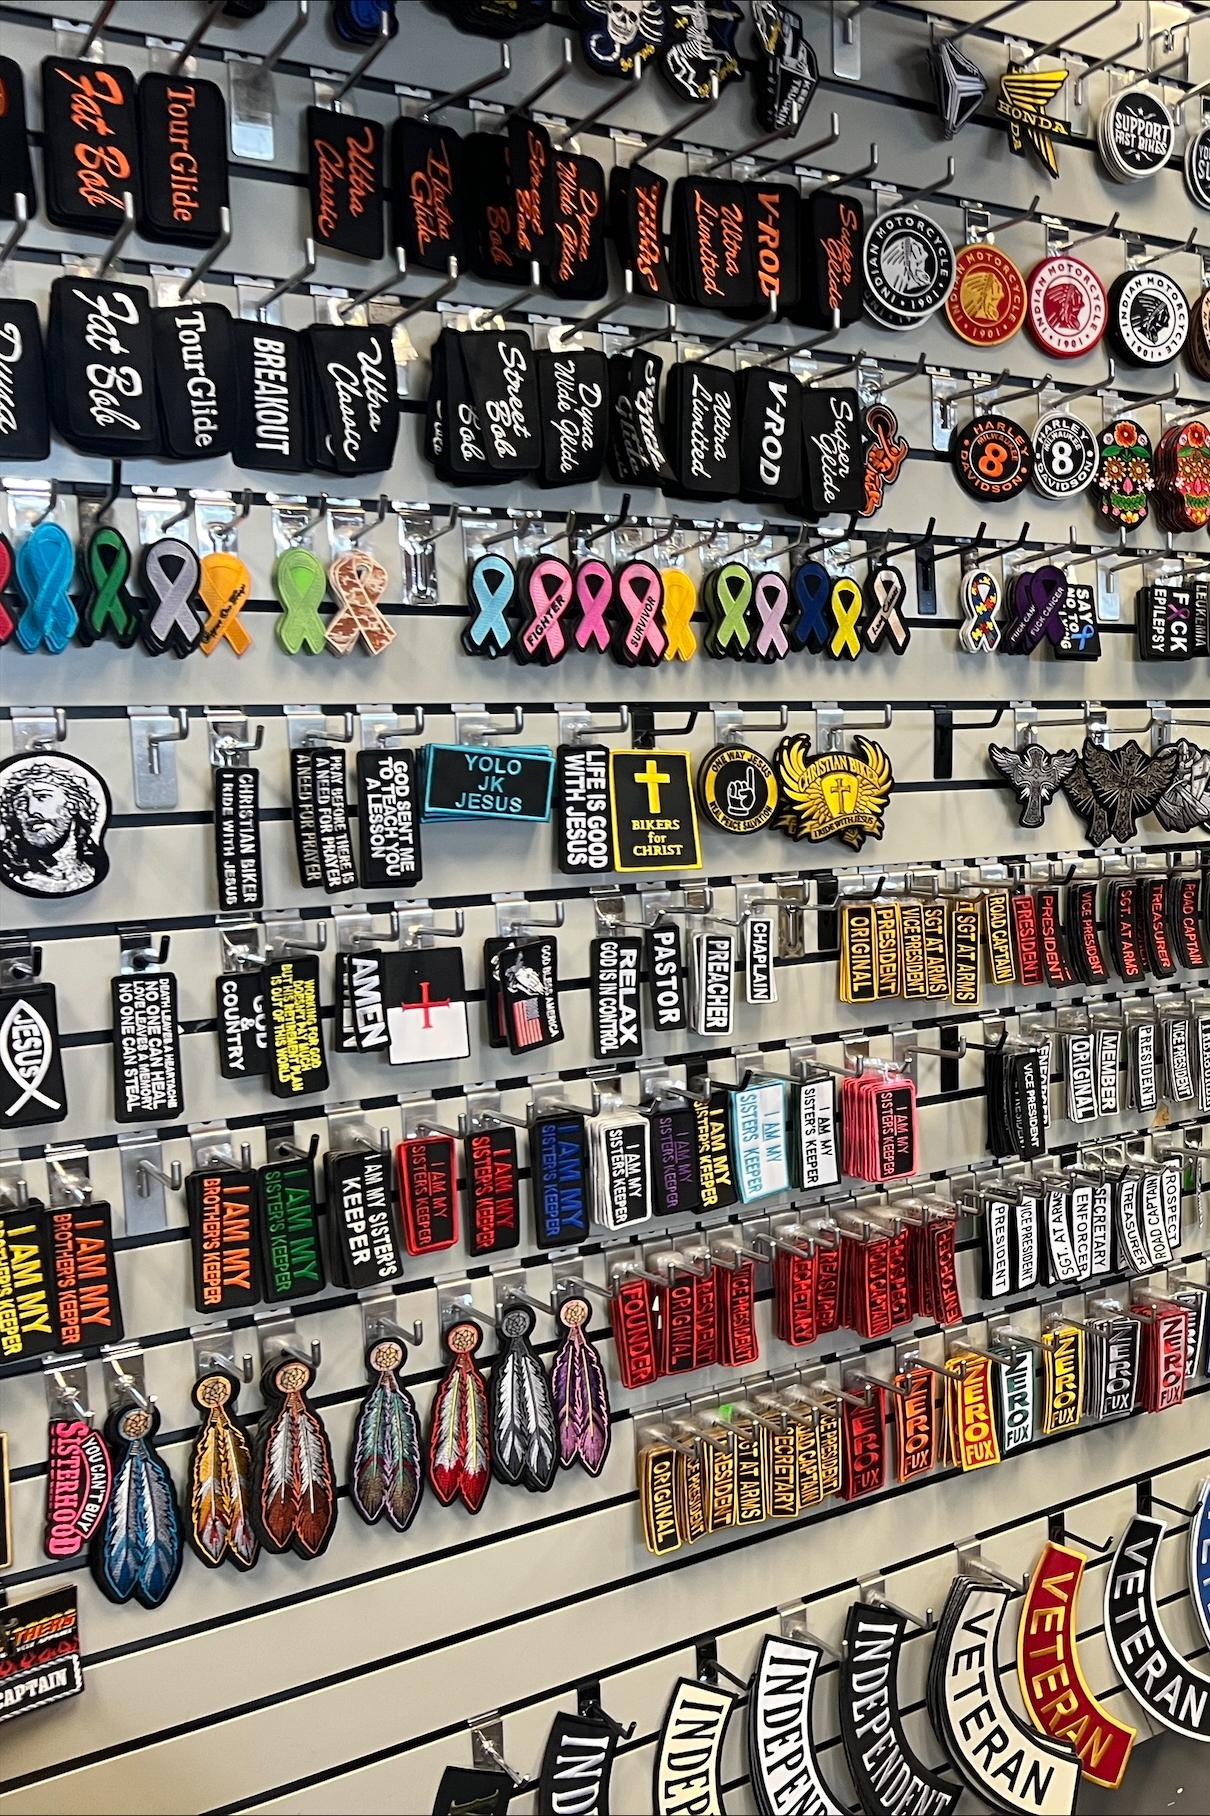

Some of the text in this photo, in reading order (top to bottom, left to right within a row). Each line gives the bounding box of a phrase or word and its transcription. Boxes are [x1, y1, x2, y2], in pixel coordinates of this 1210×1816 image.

[998, 99, 1070, 136] HONDA
[1115, 113, 1171, 140] SUPPORT
[1115, 130, 1167, 156] FAST BIKES
[314, 138, 338, 238] Classic
[347, 126, 376, 218] Ultra
[693, 189, 725, 297] Limited
[720, 203, 744, 277] Ultra
[756, 192, 781, 297] V-ROD
[838, 203, 857, 293] Super
[72, 288, 143, 432] Fat Bob
[253, 336, 290, 456] BREAKOUT
[356, 337, 388, 433] Ultra
[498, 341, 530, 439] Street
[327, 362, 356, 462] Classic
[577, 382, 602, 452] Dyna
[691, 373, 712, 479] Limited
[712, 390, 733, 463] Ultra
[759, 380, 790, 487] V-ROD
[828, 396, 852, 480] Super
[973, 421, 1030, 457] HARLEY
[1037, 419, 1089, 444] HARLEY
[812, 434, 838, 505] Glide
[961, 450, 1023, 493] DAVIDSON
[978, 442, 1008, 477] 8
[1036, 461, 1094, 491] DAVIDSON
[1051, 441, 1073, 475] 8
[526, 594, 567, 647] FIGHTER
[629, 594, 656, 648] SURVIVOR
[1043, 586, 1065, 617] CANCER
[1076, 588, 1093, 625] SAY
[1152, 588, 1167, 652] EPILEPSY
[455, 791, 523, 813] JESUS
[463, 754, 522, 774] YOLO
[477, 776, 503, 793] JK
[727, 751, 773, 779] WAY JESUS
[799, 754, 849, 791] CHRISTIAN
[222, 783, 238, 906] RIDE WITH JESUS
[238, 773, 257, 903] CHRISTIAN BIKER
[367, 793, 386, 859] LESSON
[378, 756, 401, 877] TO TEACH YOU
[393, 761, 415, 873] GOD SENT ME
[564, 754, 588, 868] WITH JESUS
[585, 749, 609, 870] LIFE GOOD
[631, 818, 681, 831] BIKERS
[632, 844, 683, 857] CHRIST
[647, 832, 667, 844] for
[751, 922, 770, 1000] CHAPLAIN
[850, 916, 872, 992] ORIGINAL
[877, 909, 897, 994] PRESIDENT
[956, 915, 976, 1001] SGT AT ARMS
[989, 896, 1012, 979] ROAD CAPTAIN
[1041, 895, 1064, 982] PRESIDENT
[1151, 884, 1171, 969] TREASURER
[352, 957, 388, 1049] AMEN
[599, 942, 619, 1054] GOD CONTROL
[619, 949, 638, 1046] RELAX
[653, 932, 680, 1024] PASTOR
[706, 939, 729, 1029] PREACHER
[9, 1014, 43, 1080] JESUS
[118, 983, 142, 1113] NO ONE CAN STEAL
[222, 980, 246, 1071] COUNTRY
[1071, 1038, 1095, 1121] ORIGINAL
[1100, 1034, 1119, 1111] MEMBER
[803, 1088, 819, 1184] SISTER'S KEEPER
[203, 1177, 222, 1305] BROTHER'S KEEPER
[223, 1201, 251, 1290] AM MY
[342, 1177, 372, 1266] KEEPER
[364, 1164, 398, 1278] AM MY SISTER'S
[994, 1206, 1006, 1287] PRESIDENT
[1093, 1188, 1107, 1267] SECRETARY
[1124, 1184, 1147, 1266] TREASURER
[621, 1286, 651, 1384] FOUNDER
[670, 1286, 692, 1367] ORIGINAL
[1161, 1318, 1182, 1386] ZERO
[963, 1362, 994, 1463] ZERO FUX
[48, 1421, 88, 1555] SISTERHOOD
[652, 1461, 676, 1544] ORIGINAL
[1028, 1571, 1115, 1769] VETERAN
[1114, 1537, 1209, 1728] VETERAN
[951, 1608, 1057, 1807] VETERAN
